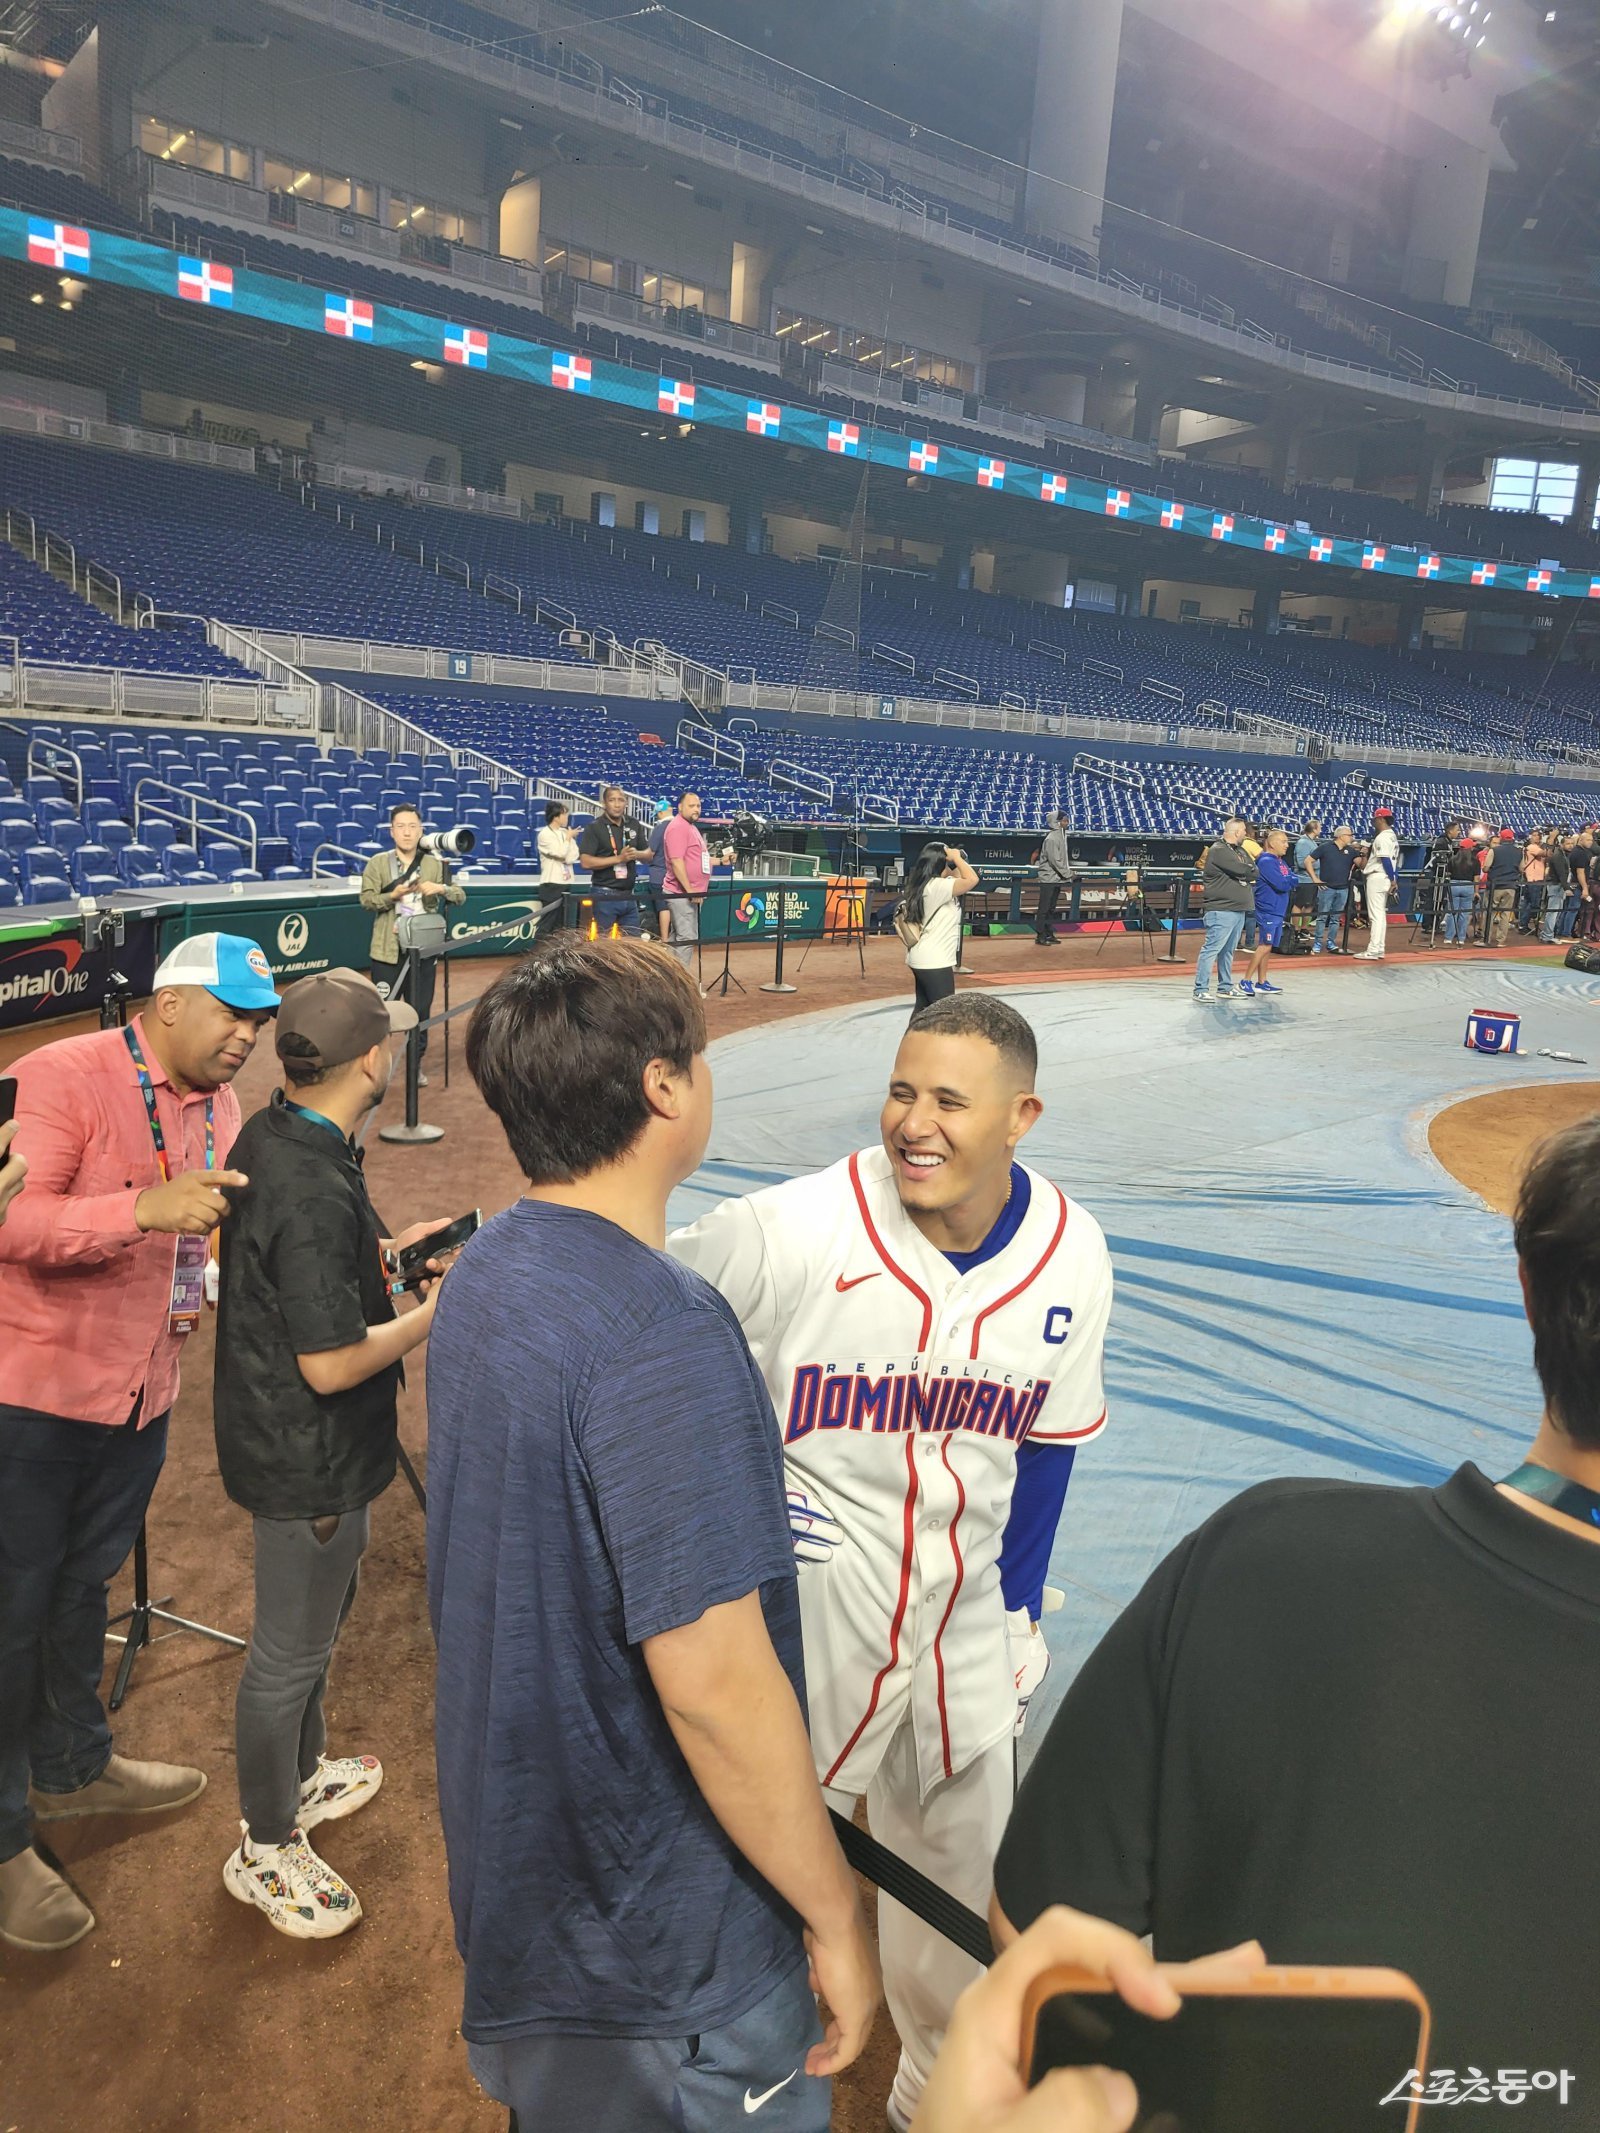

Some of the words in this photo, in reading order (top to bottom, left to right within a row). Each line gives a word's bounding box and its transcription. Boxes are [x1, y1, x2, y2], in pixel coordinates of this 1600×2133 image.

[454, 659, 467, 675] 19
[882, 702, 893, 715] 20
[1169, 730, 1177, 741] 21
[1297, 742, 1305, 753] 22
[984, 849, 1014, 858] TENTIAL
[765, 901, 810, 911] BAEBALL
[286, 943, 301, 952] JAL
[284, 959, 329, 973] AIRLINES
[1043, 1305, 1073, 1345] C
[826, 1356, 1033, 1390] REPÚBLICA
[784, 1362, 1052, 1447] DOMINICANA
